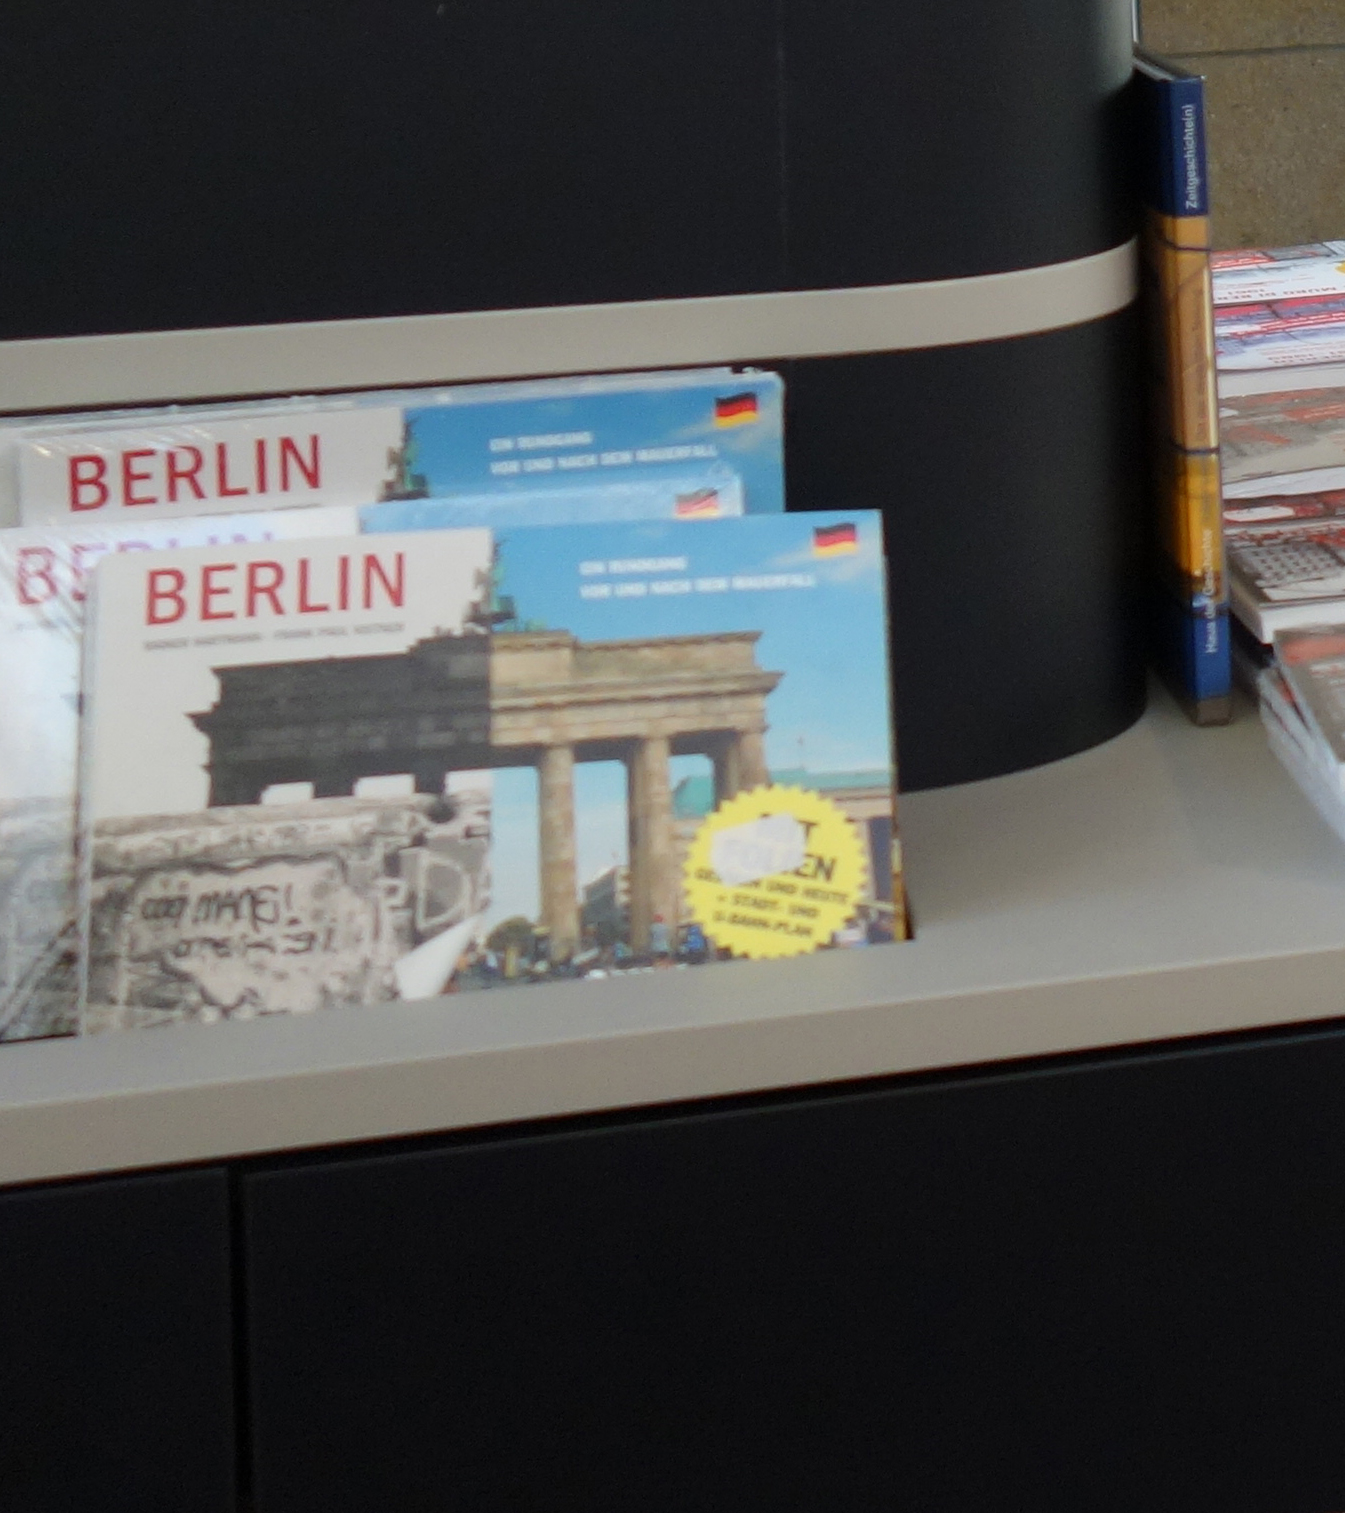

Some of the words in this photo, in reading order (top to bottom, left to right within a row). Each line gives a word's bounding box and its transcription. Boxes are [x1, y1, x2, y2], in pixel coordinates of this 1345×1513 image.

[1182, 104, 1200, 210] Zeitgeschichte(n)
[68, 433, 323, 513] BERLIN
[146, 551, 405, 626] BERLIN
